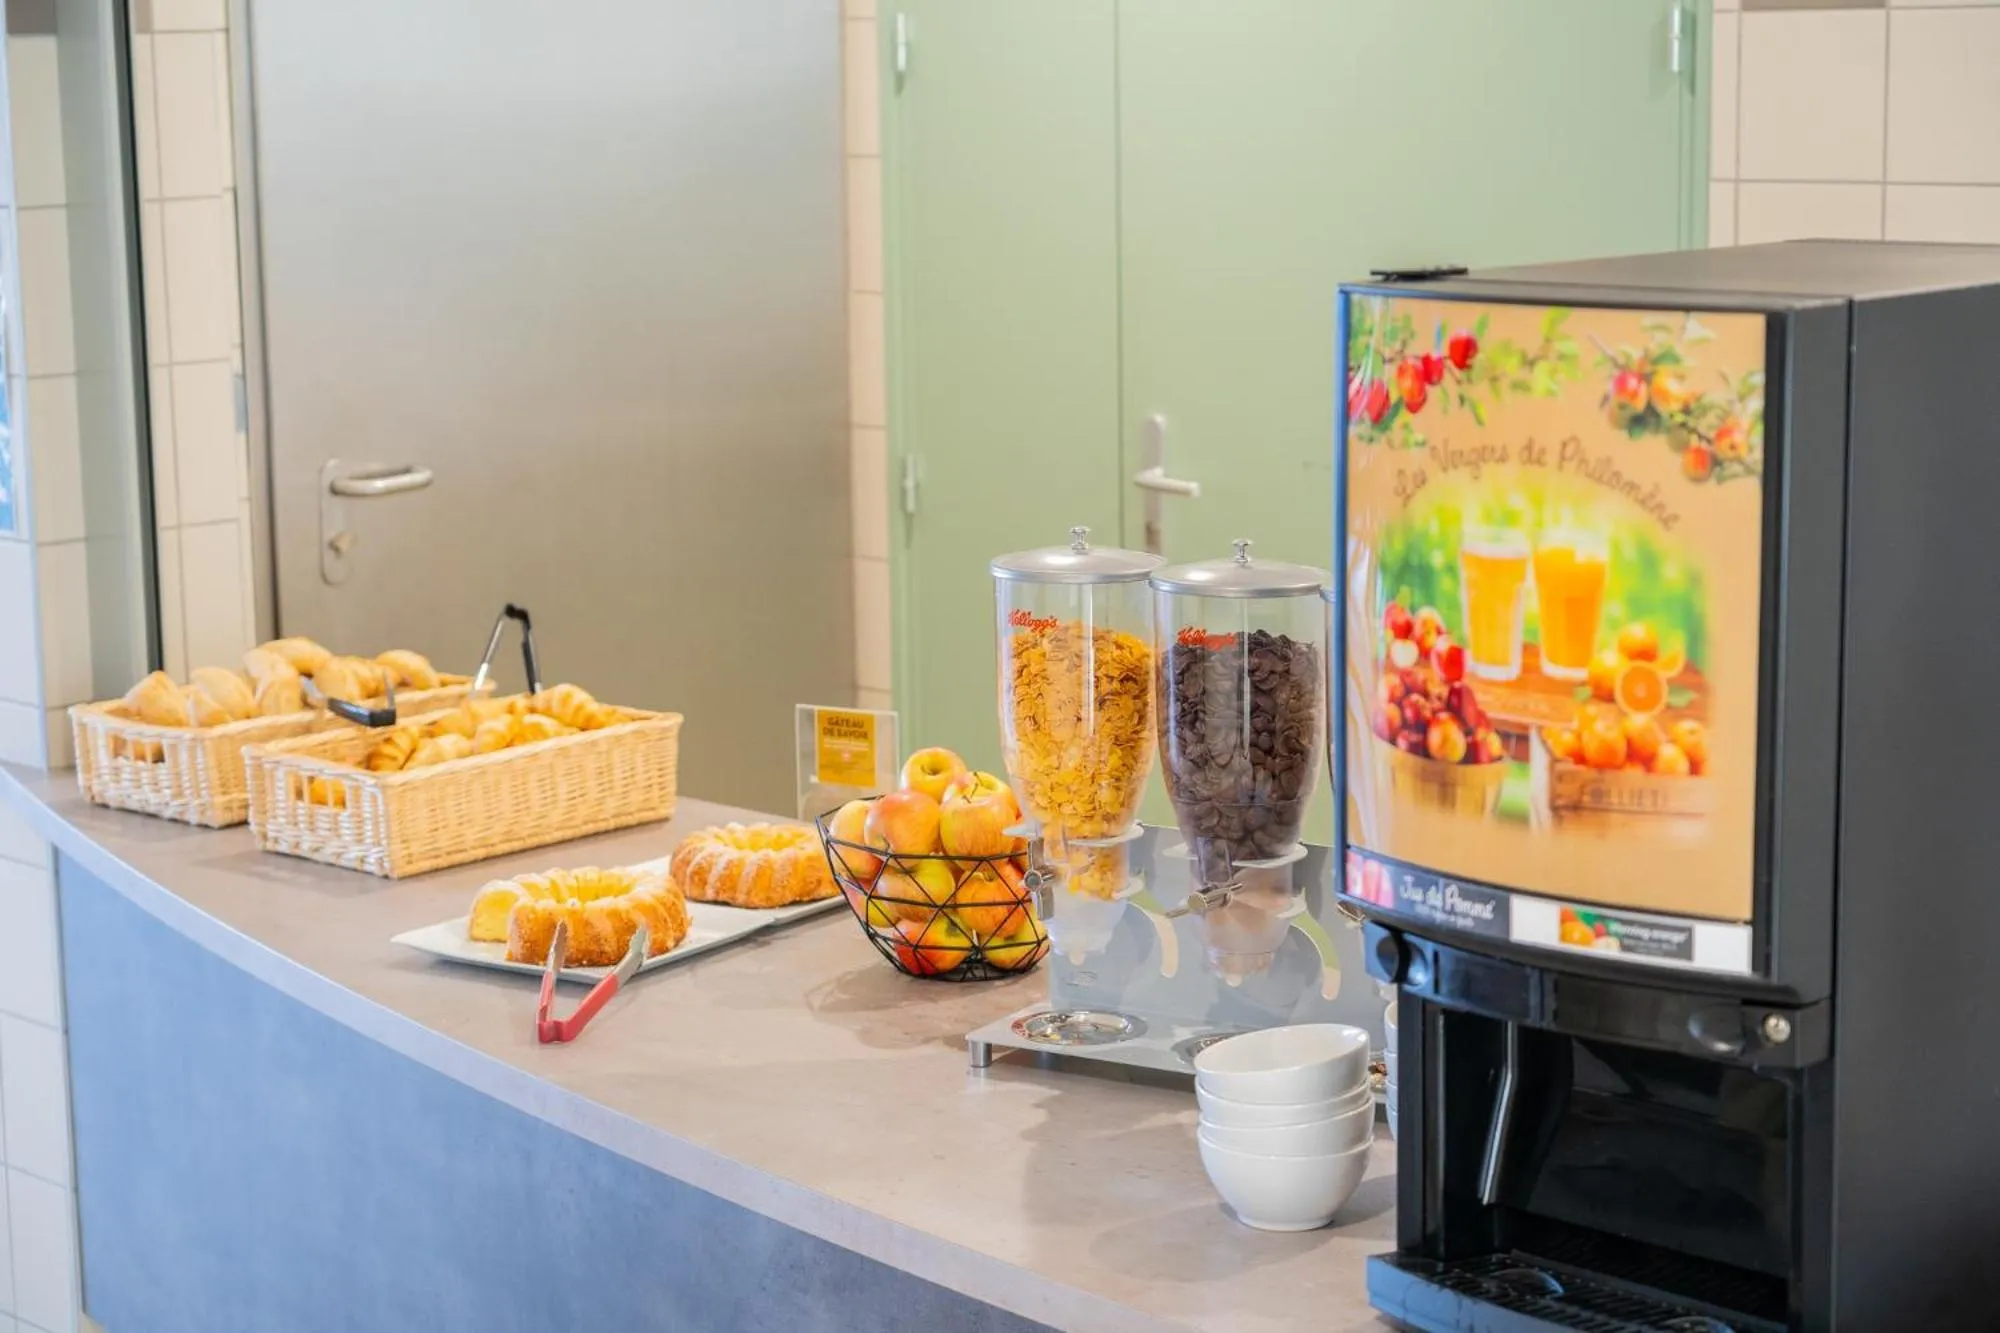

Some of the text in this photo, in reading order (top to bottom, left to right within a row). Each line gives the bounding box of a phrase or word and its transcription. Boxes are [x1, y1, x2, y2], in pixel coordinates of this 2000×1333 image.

[1429, 438, 1509, 481] Vergers
[1518, 436, 1548, 468] de
[1008, 608, 1057, 638] Kellogg's
[822, 727, 834, 737] DE
[827, 715, 865, 729] GÂTEAU
